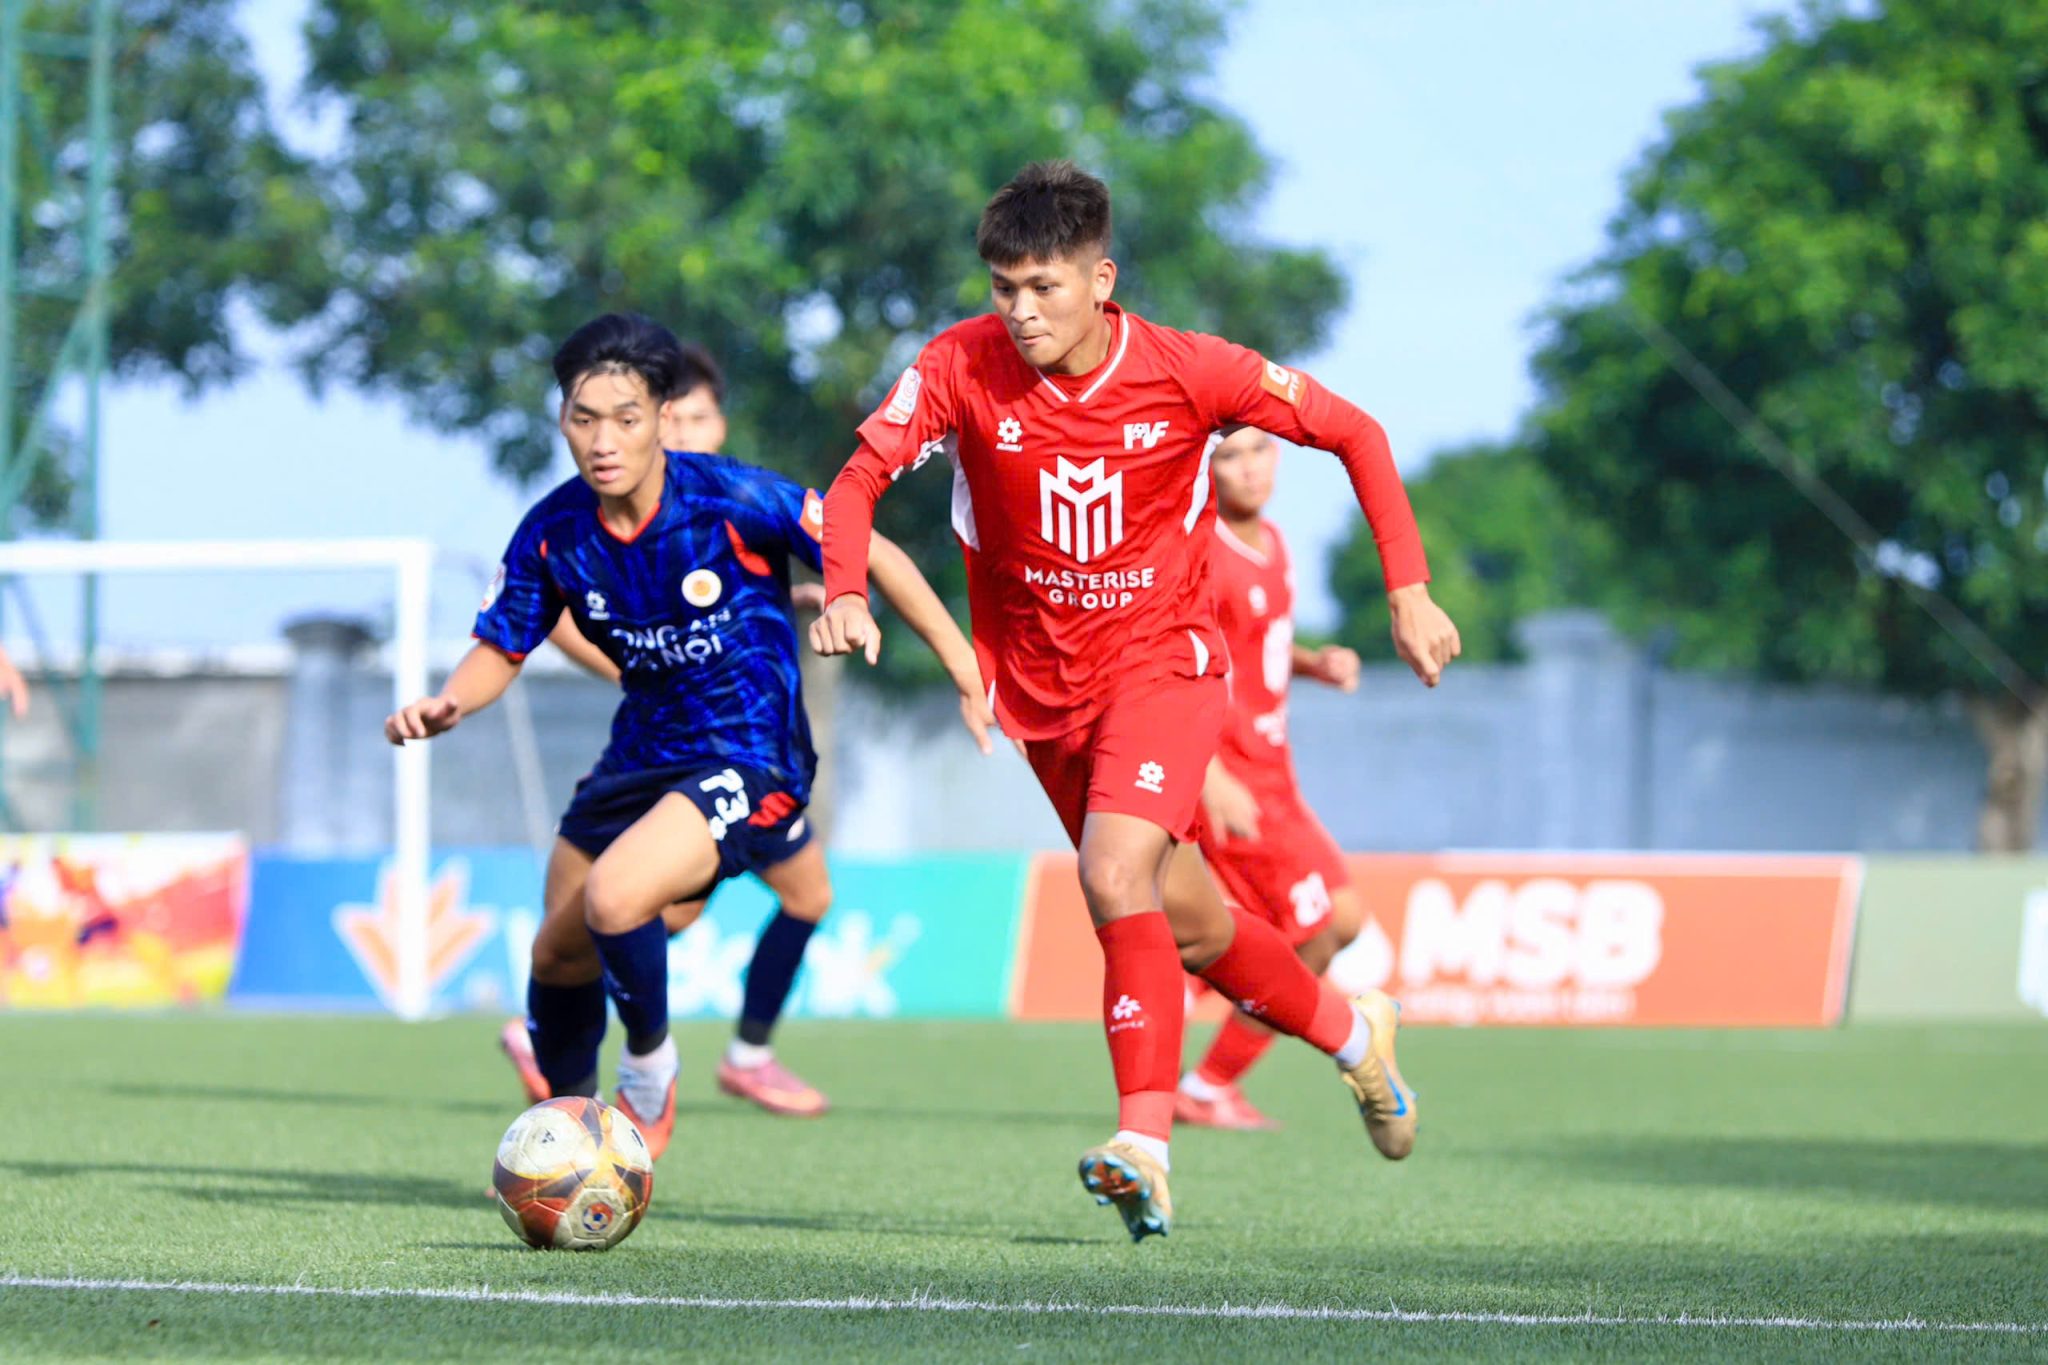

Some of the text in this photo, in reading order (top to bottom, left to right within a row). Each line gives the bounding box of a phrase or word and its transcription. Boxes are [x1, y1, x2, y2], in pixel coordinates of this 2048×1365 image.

[1025, 565, 1155, 590] MASTERISE
[1048, 588, 1133, 609] GROUP
[699, 768, 750, 824] 73
[1402, 877, 1664, 985] MSB
